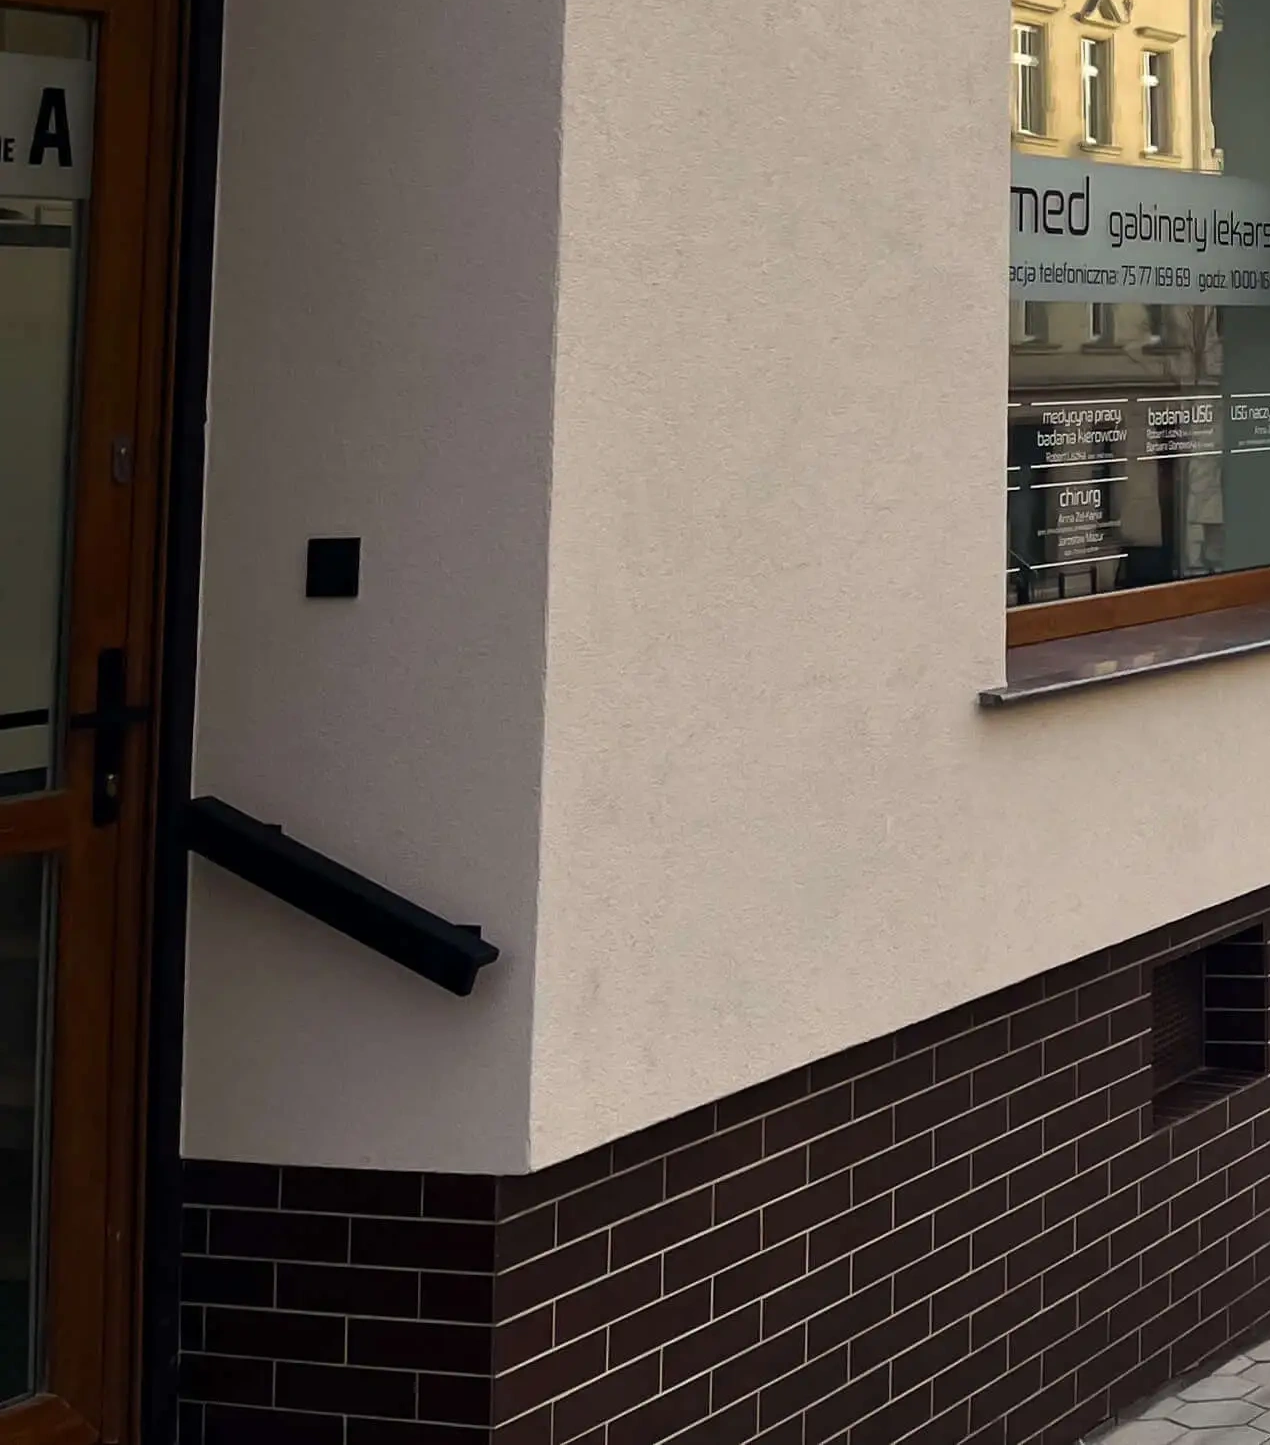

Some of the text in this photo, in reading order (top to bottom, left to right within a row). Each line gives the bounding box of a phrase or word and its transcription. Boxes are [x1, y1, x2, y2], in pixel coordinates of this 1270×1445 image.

[28, 87, 73, 167] A
[1010, 175, 1091, 236] med
[1109, 201, 1207, 252] gabinety
[1121, 265, 1136, 286] 75
[1139, 265, 1152, 286] 77
[1175, 267, 1190, 287] 69
[1042, 409, 1093, 426] medycyna
[1148, 403, 1213, 426] badania USG
[1231, 405, 1248, 421] USG
[1037, 430, 1077, 446] badania
[1060, 487, 1101, 507] chirurg
